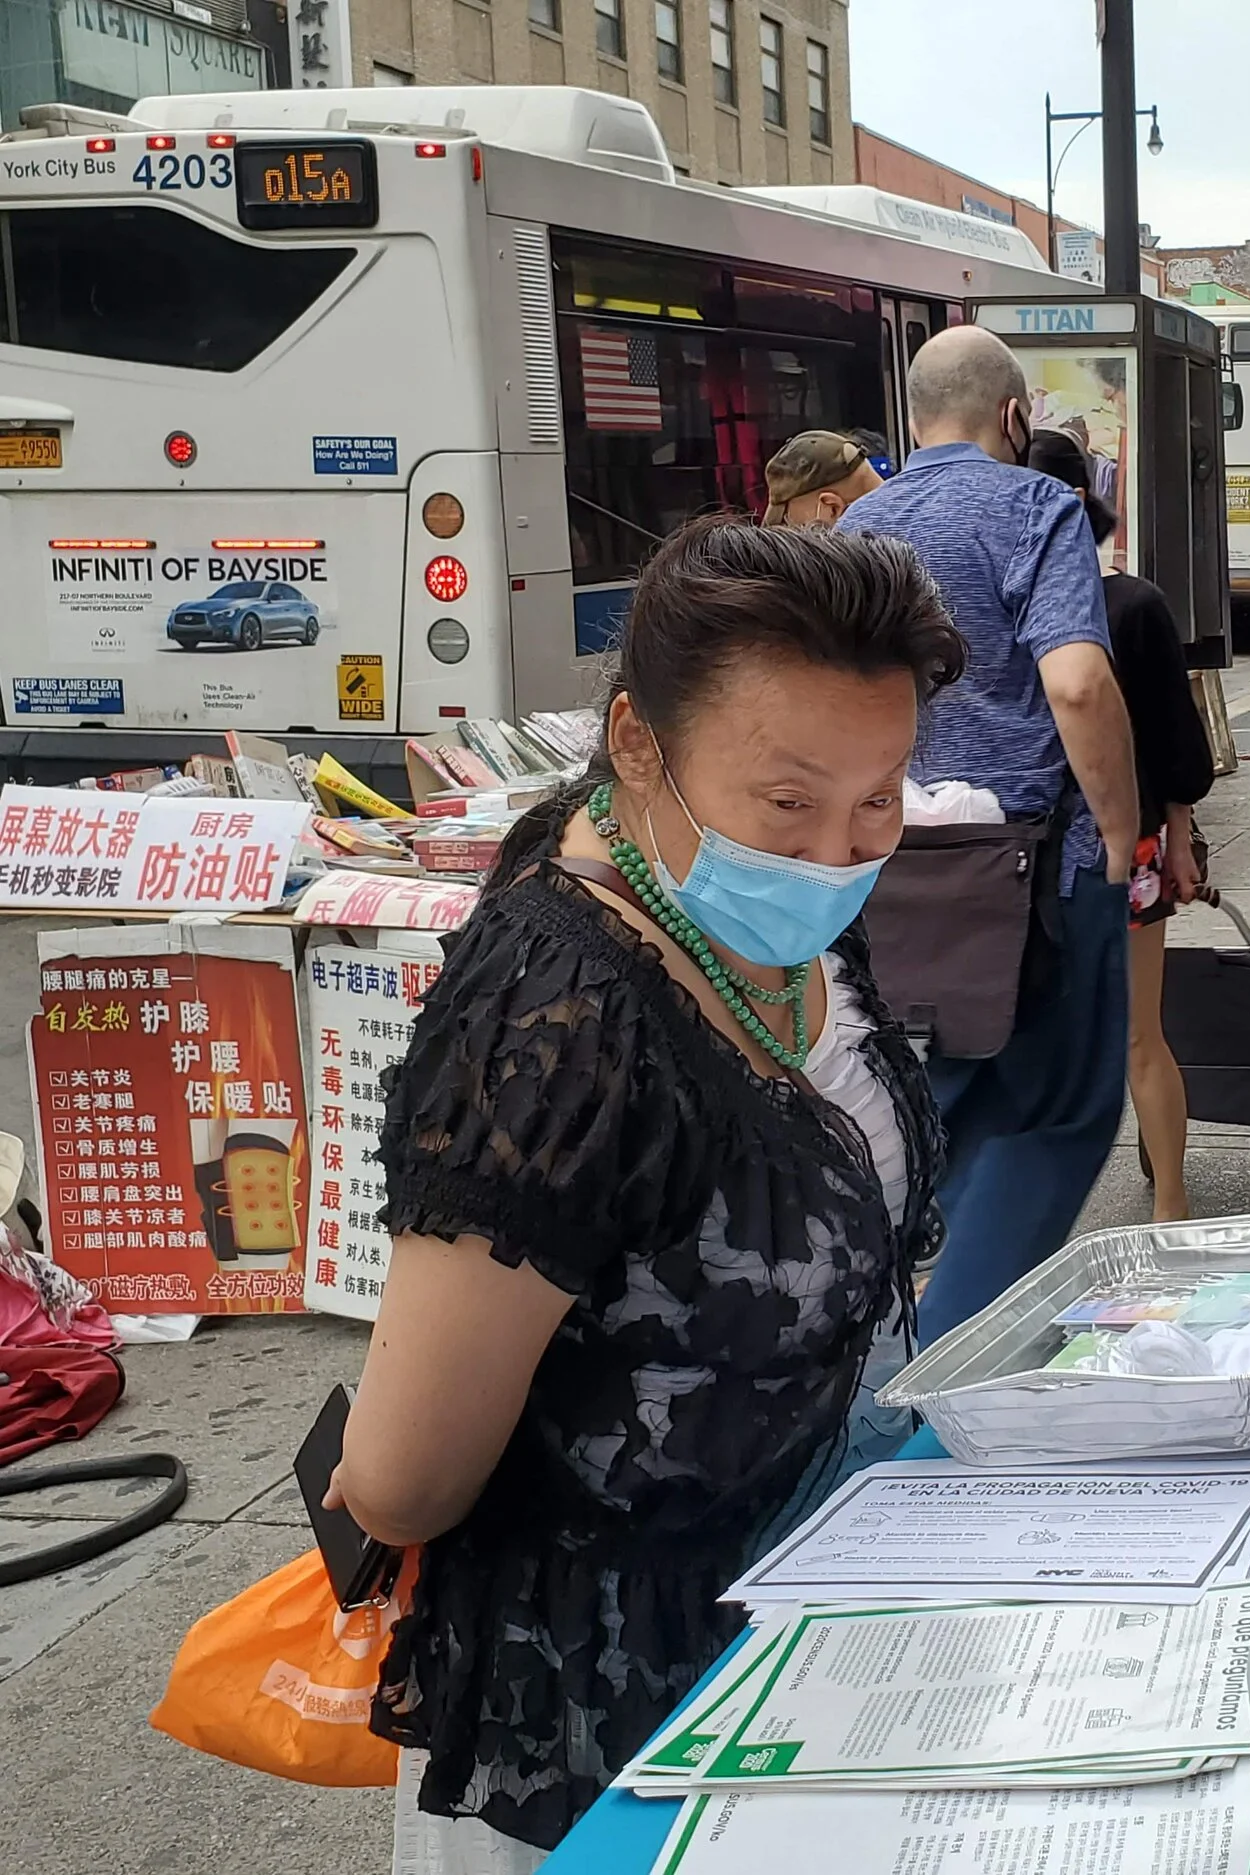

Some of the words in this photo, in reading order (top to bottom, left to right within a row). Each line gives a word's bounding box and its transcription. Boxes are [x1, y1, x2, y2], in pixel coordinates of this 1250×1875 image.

[170, 22, 255, 78] SQUARE
[3, 160, 41, 179] York
[45, 159, 79, 179] City
[84, 157, 116, 175] Bus
[133, 154, 233, 191] 4203
[1016, 309, 1094, 331] TITAN
[29, 440, 57, 459] 9550
[315, 439, 352, 449] SAFETY'S
[354, 439, 371, 449] OUR
[372, 439, 394, 449] GOAL
[315, 450, 333, 459] How
[335, 450, 349, 459] Are
[350, 450, 364, 459] We
[365, 450, 394, 461] Doing?
[339, 461, 355, 470] Call
[51, 558, 153, 582] INFINITI
[161, 557, 200, 582] OF
[208, 557, 328, 582] BAYSIDE
[340, 656, 381, 665] CAUTION
[15, 680, 37, 690] KEEP
[39, 680, 57, 690] BUS
[59, 680, 88, 690] LANES
[90, 680, 119, 691] CLEAR
[113, 691, 120, 699] TO
[203, 701, 244, 710] Technology
[341, 701, 383, 713] WIDE
[190, 812, 255, 839] 厨房
[137, 843, 281, 902] 防油贴
[45, 1001, 130, 1033] 自发热
[140, 1000, 210, 1035] 护膝
[171, 1040, 240, 1074] 护腰
[71, 1069, 132, 1088] 关节炎
[73, 1093, 135, 1110] 老寒腿
[184, 1080, 292, 1115] 保暖贴
[75, 1115, 157, 1134] 关节疼痛
[76, 1139, 159, 1157] 骨质增生
[78, 1162, 161, 1180] 腰肌劳损
[84, 1231, 207, 1249] 腿部肌肉酸痛
[344, 1274, 385, 1300] 伤害和
[908, 1489, 935, 1497] EN
[1076, 1488, 1143, 1496] NUEVA
[1152, 1487, 1209, 1495] YORK!
[1117, 1481, 1151, 1489] DEL
[1159, 1479, 1249, 1489] COVID-19
[1036, 1568, 1084, 1577] NYC
[789, 1626, 833, 1691] 2020CENSUS.GOV/es
[1216, 1646, 1250, 1731] preguntamos
[709, 1792, 740, 1841] SUS.GOV/ko
